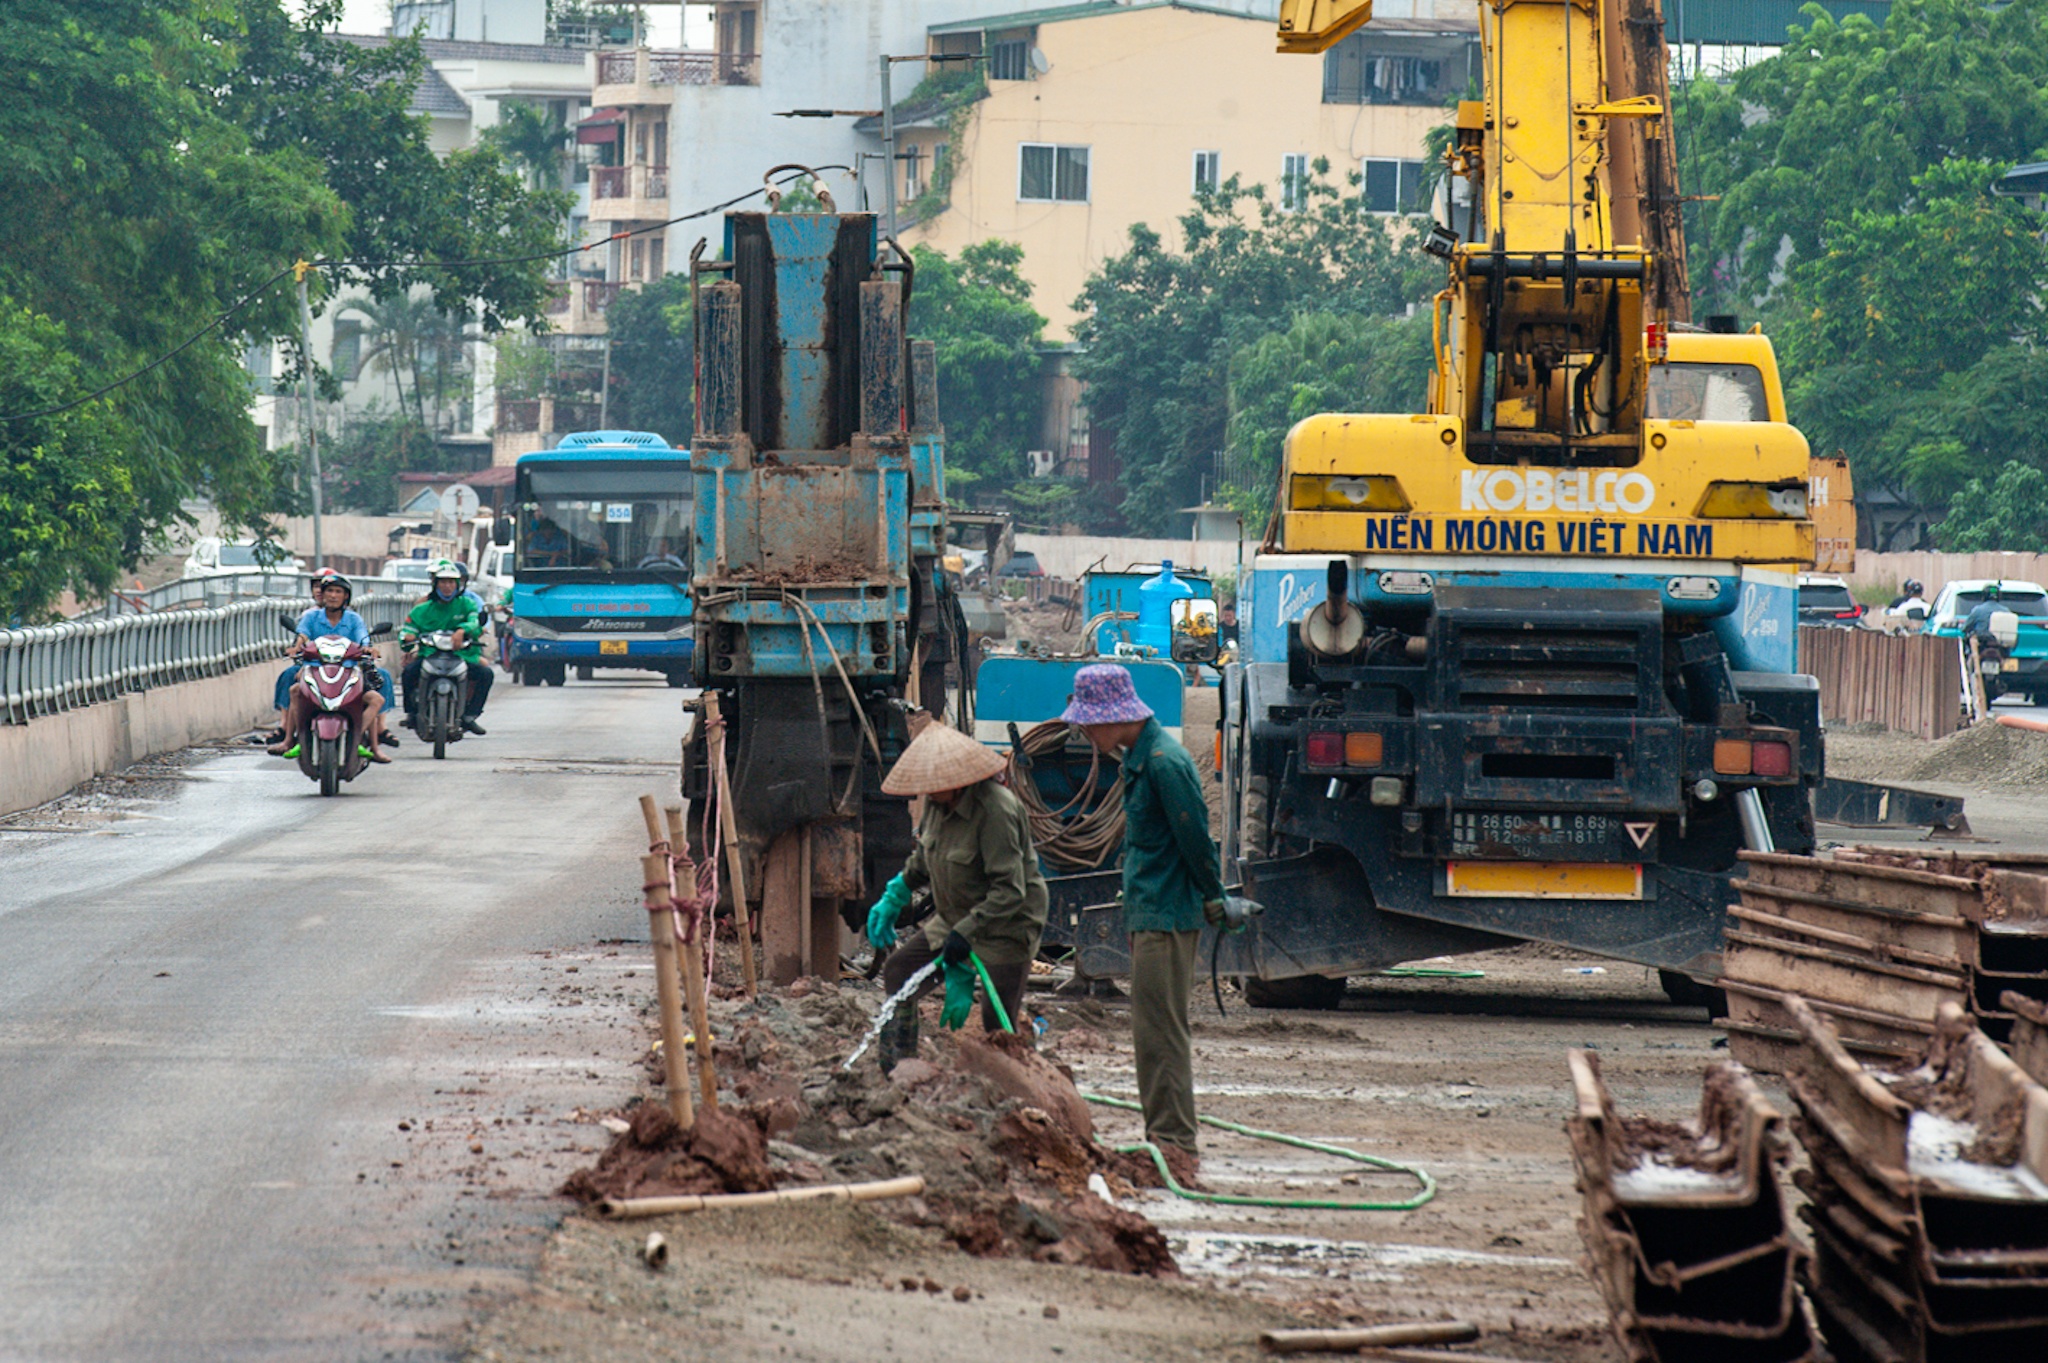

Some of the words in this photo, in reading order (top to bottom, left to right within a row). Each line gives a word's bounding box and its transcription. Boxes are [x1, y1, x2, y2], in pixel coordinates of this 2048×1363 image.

[1461, 469, 1655, 514] KOBELCO
[1445, 516, 1545, 551] MÓNG
[1638, 523, 1713, 555] NAM
